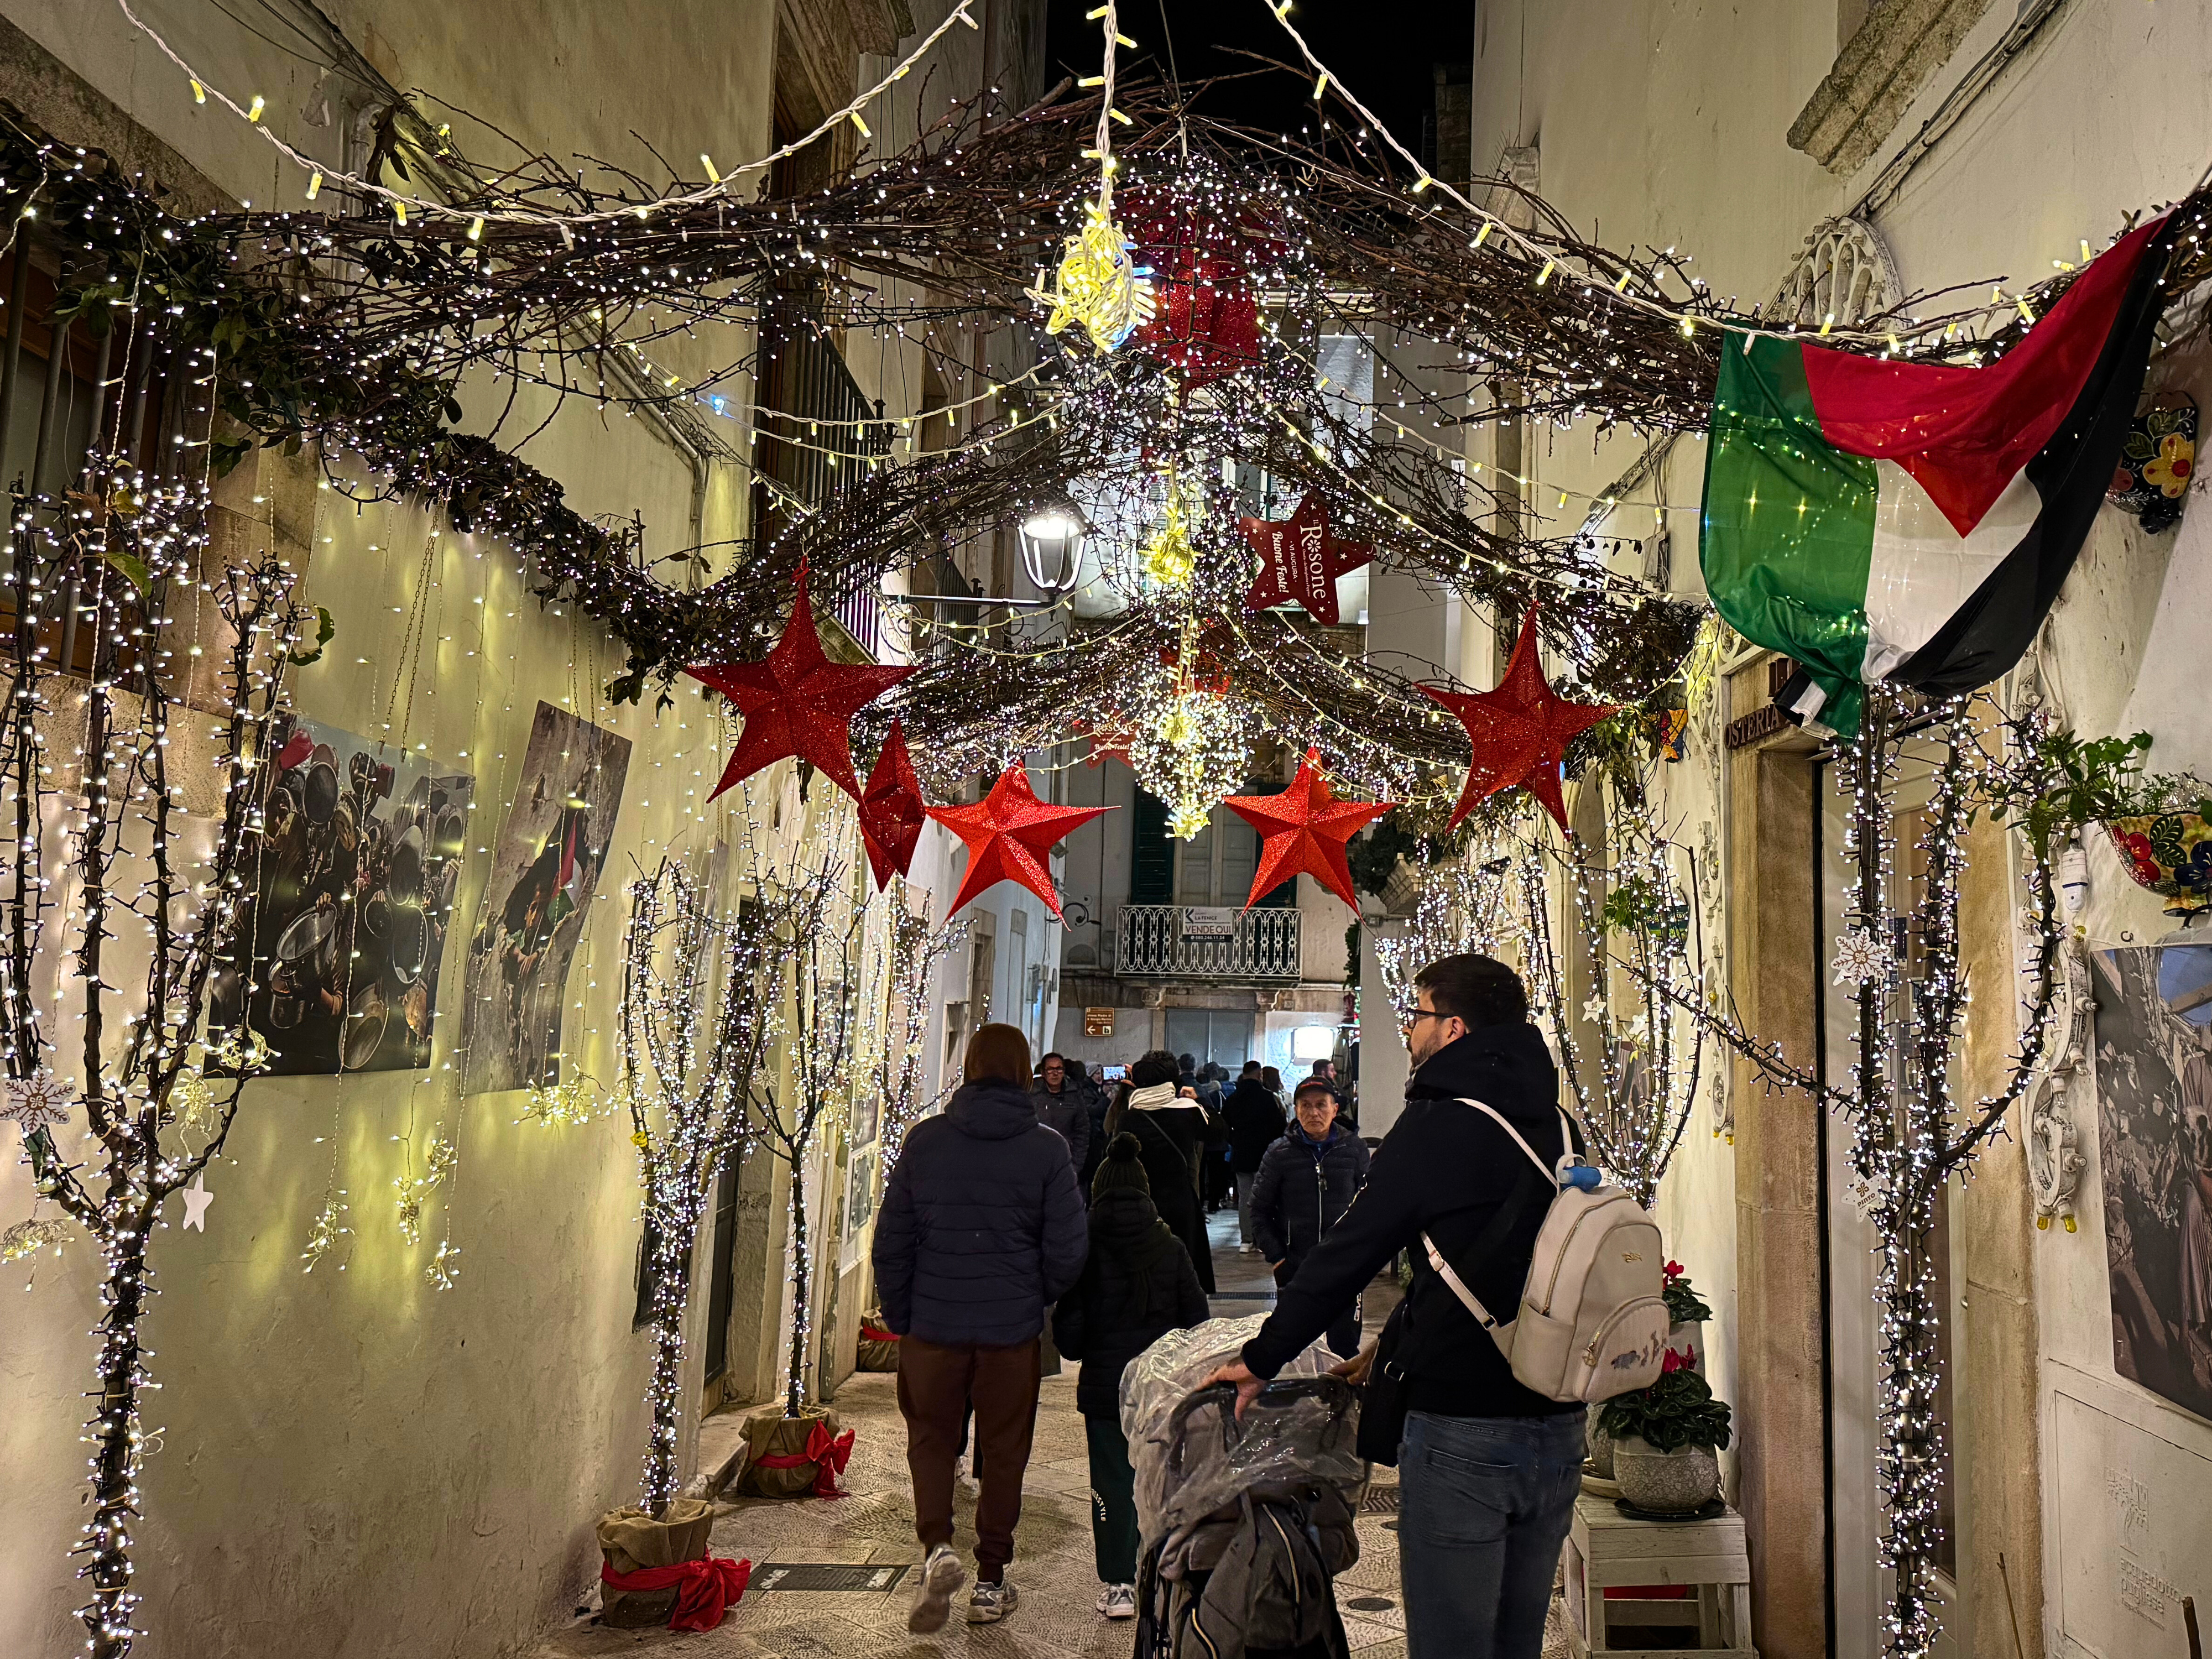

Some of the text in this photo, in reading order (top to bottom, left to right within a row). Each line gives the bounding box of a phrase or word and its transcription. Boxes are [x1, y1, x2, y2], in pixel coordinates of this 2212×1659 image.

[1272, 531, 1290, 593] Buone Feste!
[1185, 925, 1231, 934] VENDE QUI
[1857, 1192, 1876, 1207] PINTO
